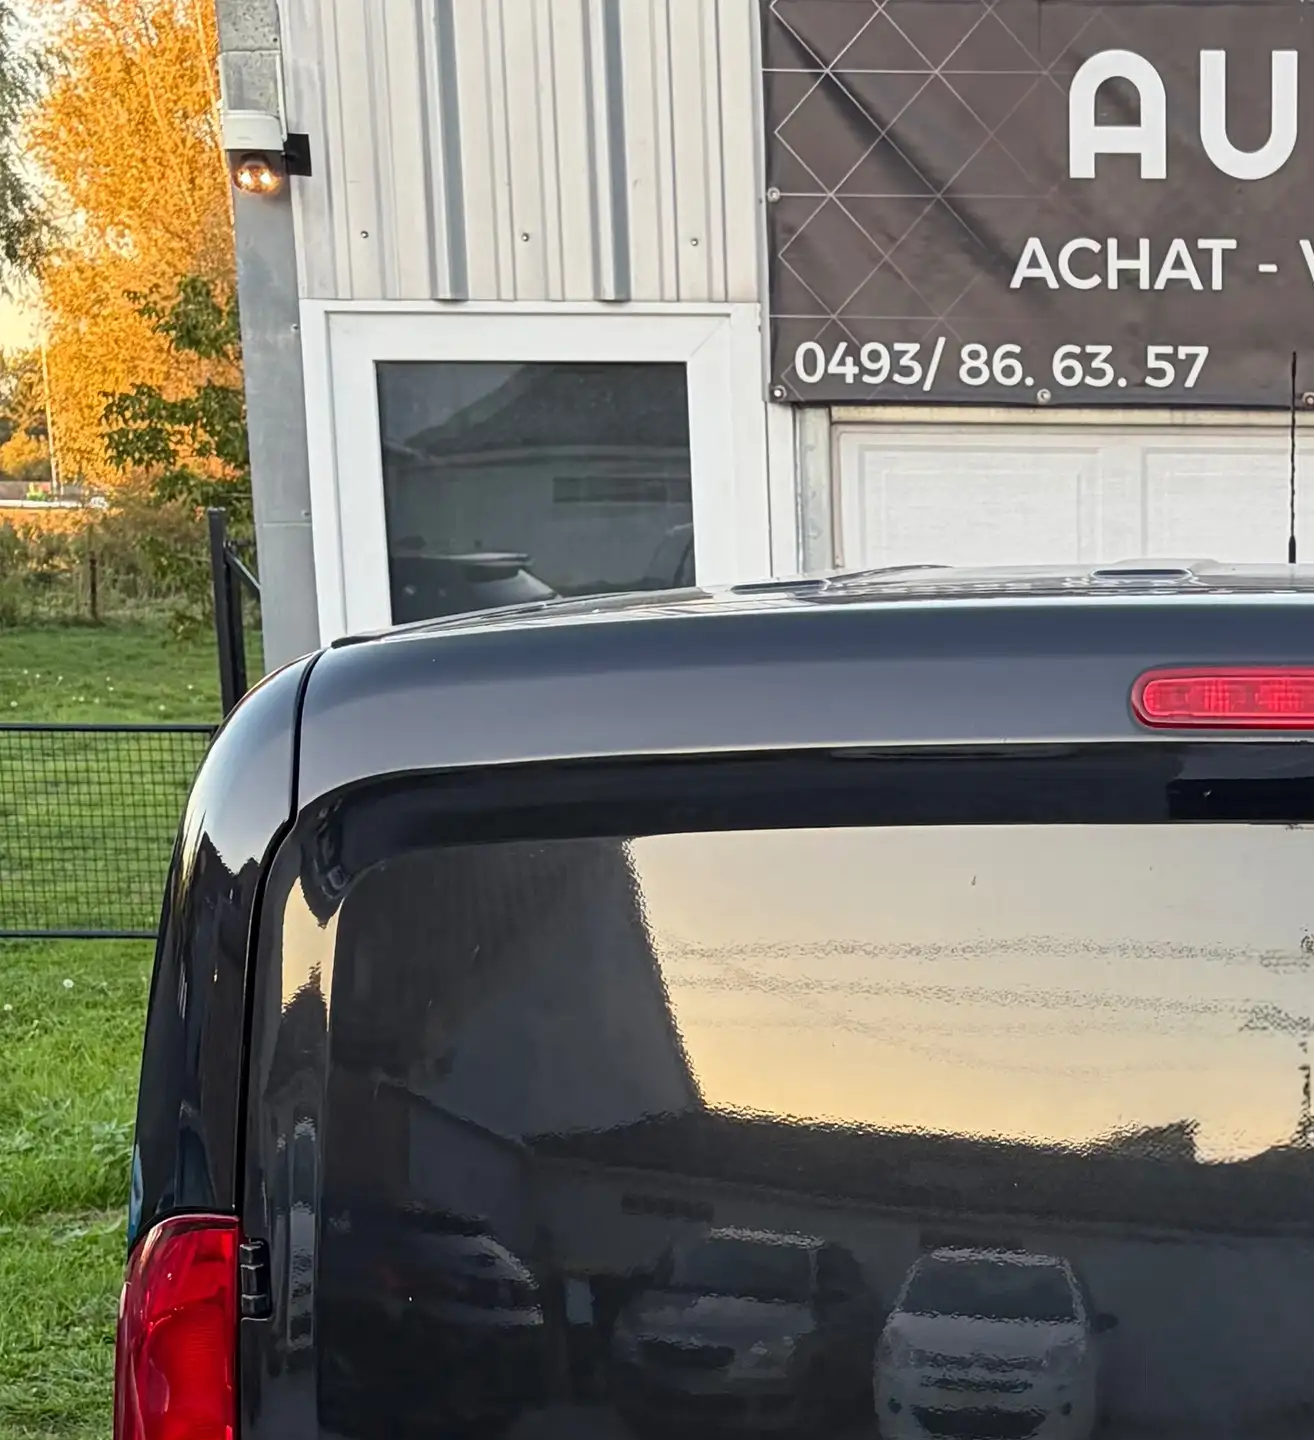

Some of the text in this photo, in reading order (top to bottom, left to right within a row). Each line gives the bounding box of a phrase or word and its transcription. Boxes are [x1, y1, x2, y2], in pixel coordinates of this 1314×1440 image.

[1010, 238, 1237, 292] ACHAT
[794, 336, 1210, 391] 0493/ 86. 63. 57
